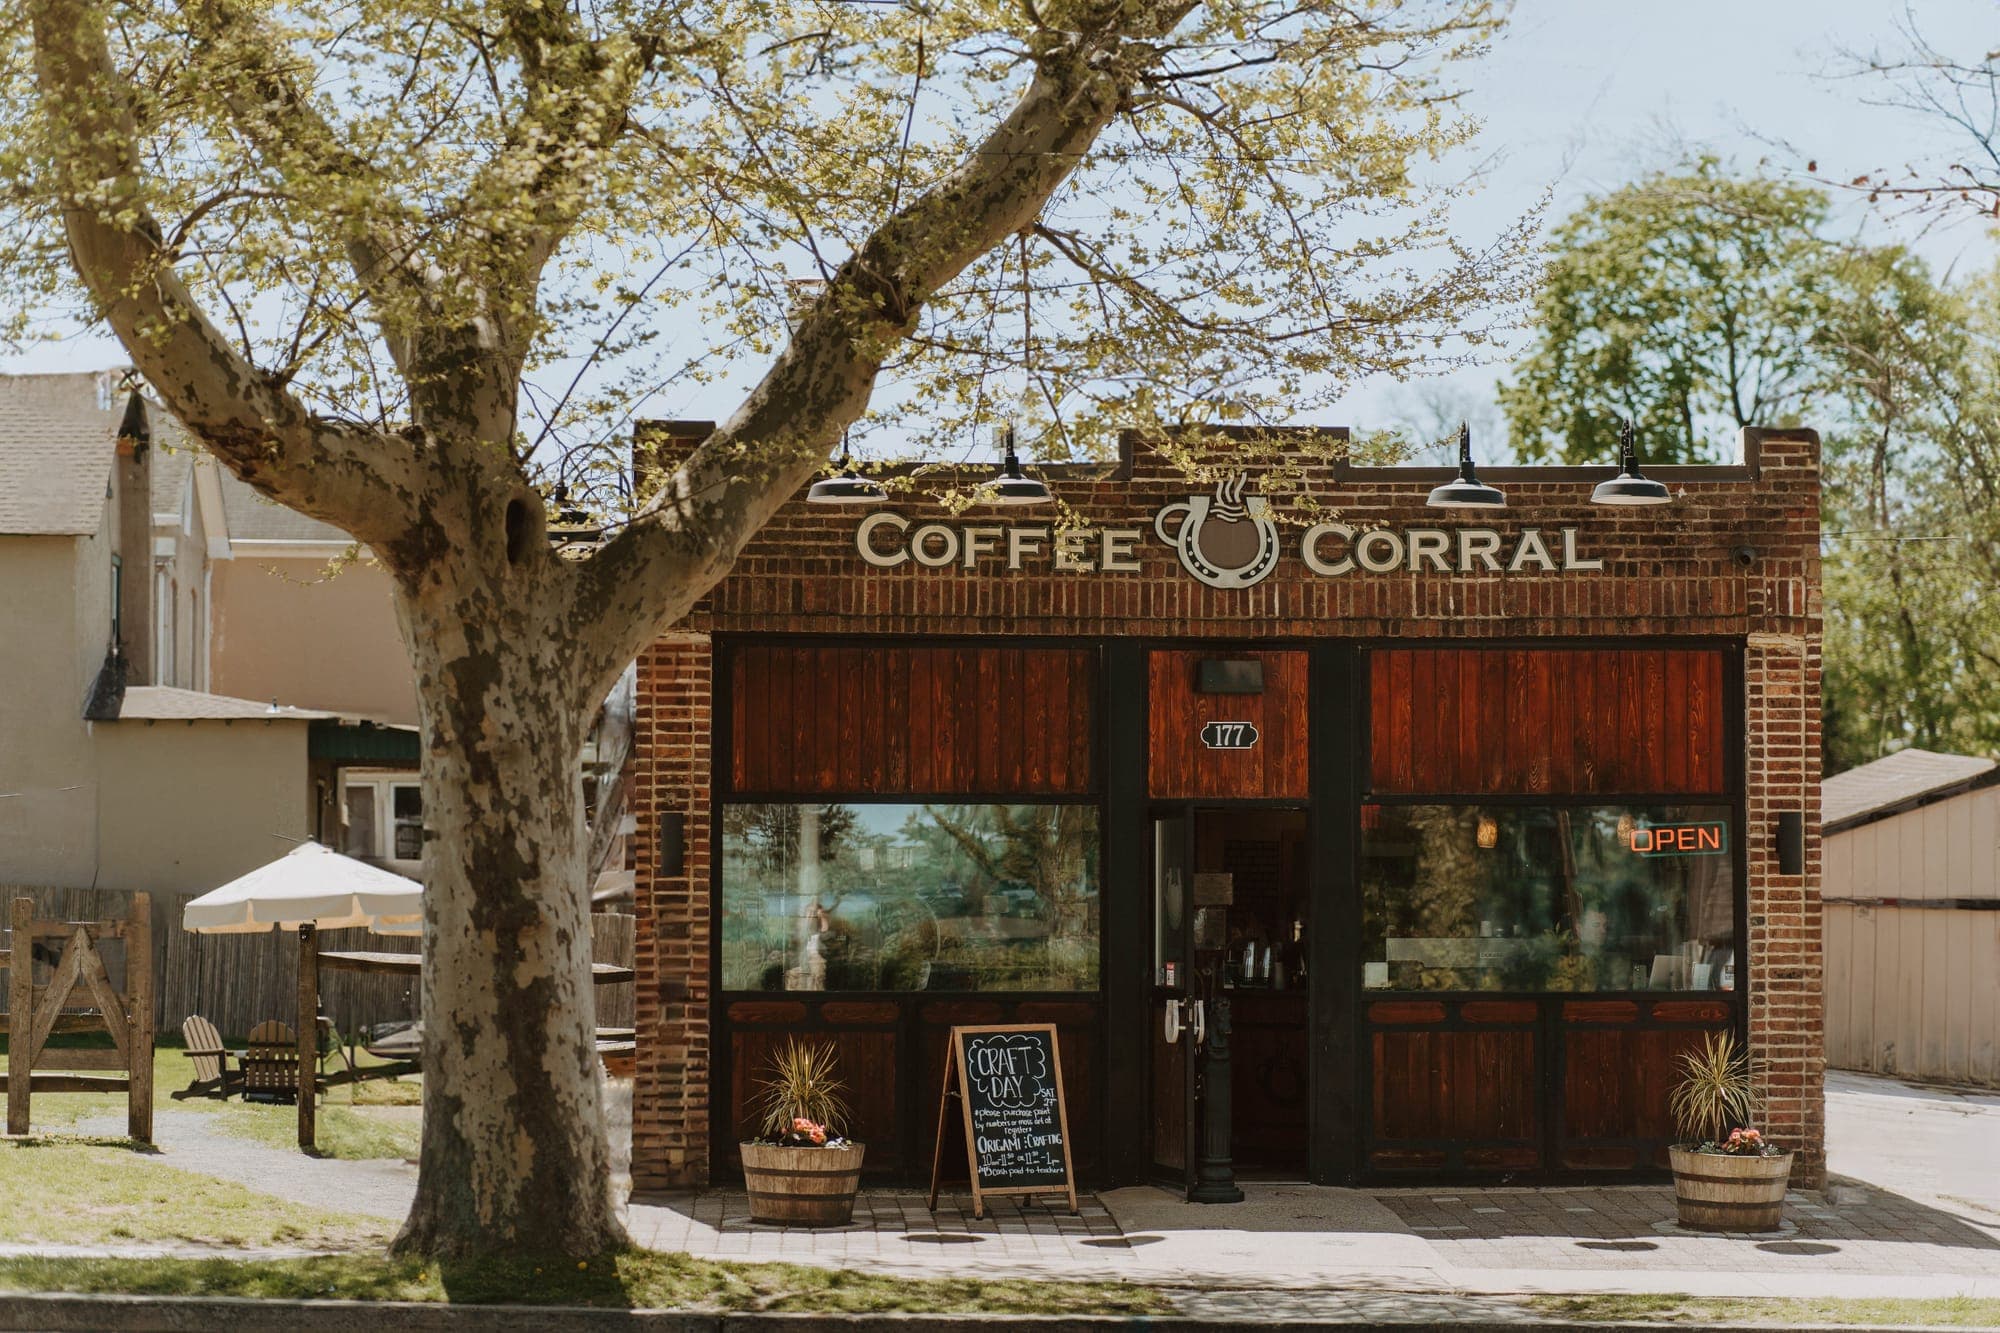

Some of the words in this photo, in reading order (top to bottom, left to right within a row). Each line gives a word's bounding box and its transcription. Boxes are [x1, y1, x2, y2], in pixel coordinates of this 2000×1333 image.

[855, 512, 1142, 572] COFFEE
[1302, 521, 1603, 576] CORRAL
[1215, 724, 1245, 747] 177
[1630, 827, 1720, 852] OPEN
[977, 1046, 1032, 1076] CRAFT
[991, 1075, 1023, 1098] DAY
[1040, 1087, 1055, 1098] SAT
[974, 1120, 984, 1133] by
[985, 1119, 1010, 1128] numbers
[977, 1135, 1022, 1153] ORIGAMI
